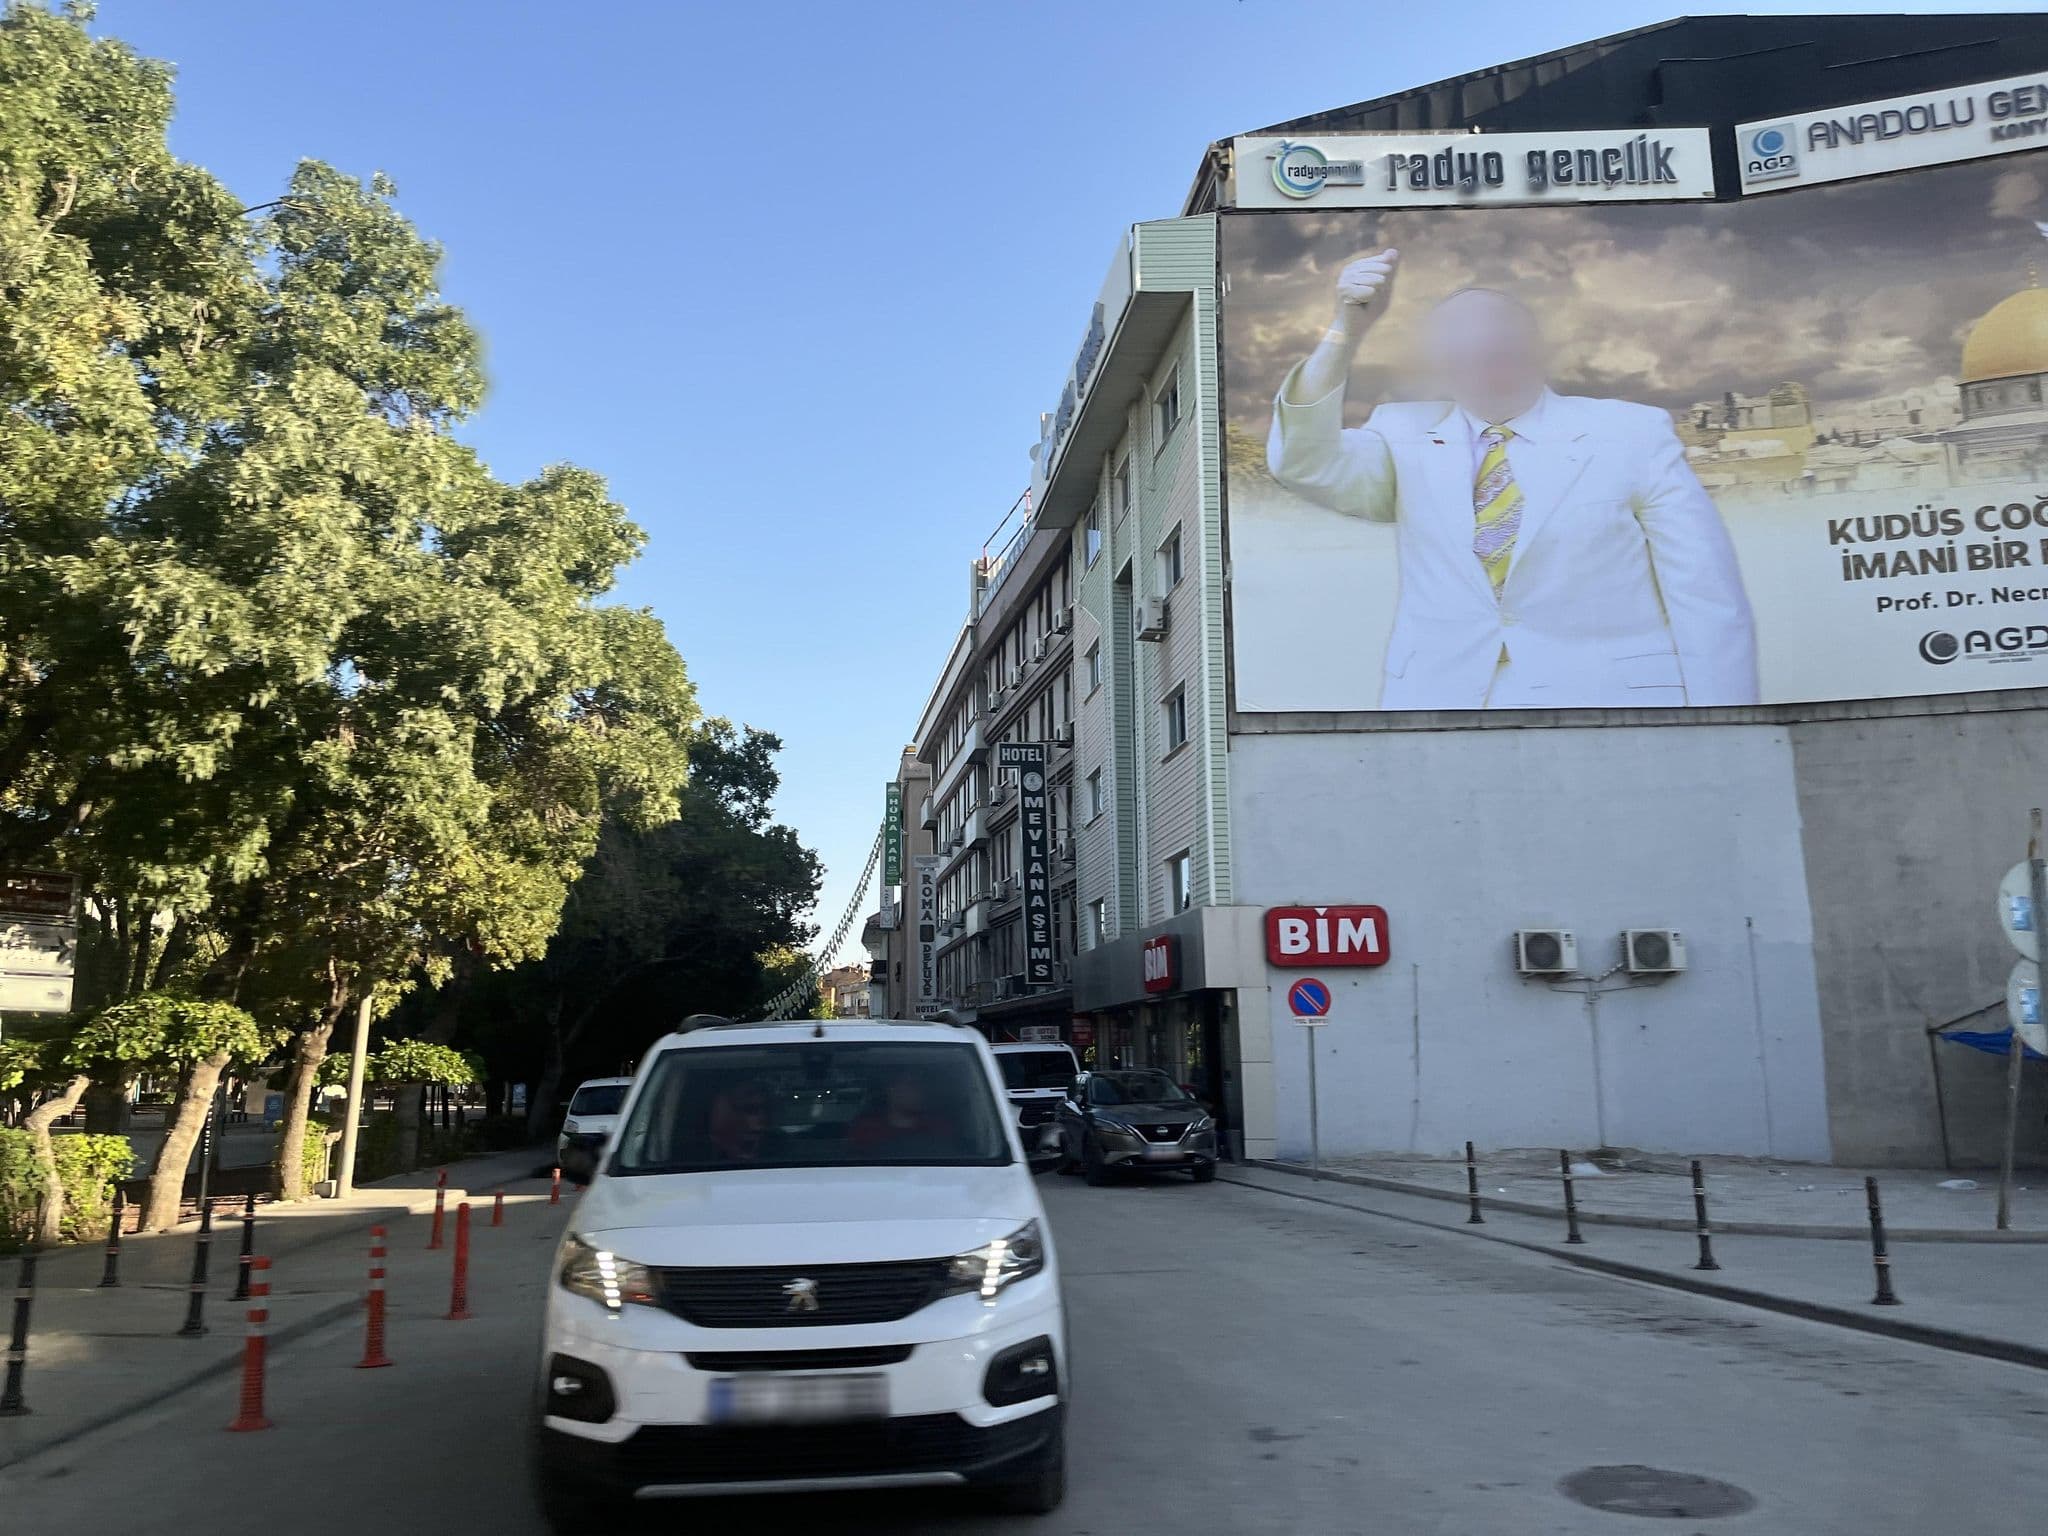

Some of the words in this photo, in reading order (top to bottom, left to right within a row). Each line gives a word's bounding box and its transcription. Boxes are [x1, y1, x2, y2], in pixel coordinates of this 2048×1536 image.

[1808, 96, 1975, 152] ANADOLU
[1387, 145, 1504, 195] radyo
[1526, 133, 1679, 195] gençlik
[1749, 154, 1796, 173] AGD
[1828, 503, 1965, 546] KUDÜS
[1842, 539, 1958, 582] İMANİ
[1966, 535, 2032, 571] BİR
[1877, 591, 1938, 613] Prof.
[1946, 590, 1983, 608] Dr.
[1964, 625, 2048, 653] AGD
[1001, 748, 1043, 762] HOTEL
[920, 874, 934, 921] ROMA
[1278, 907, 1380, 955] BİM
[915, 1005, 939, 1014] HOTEL
